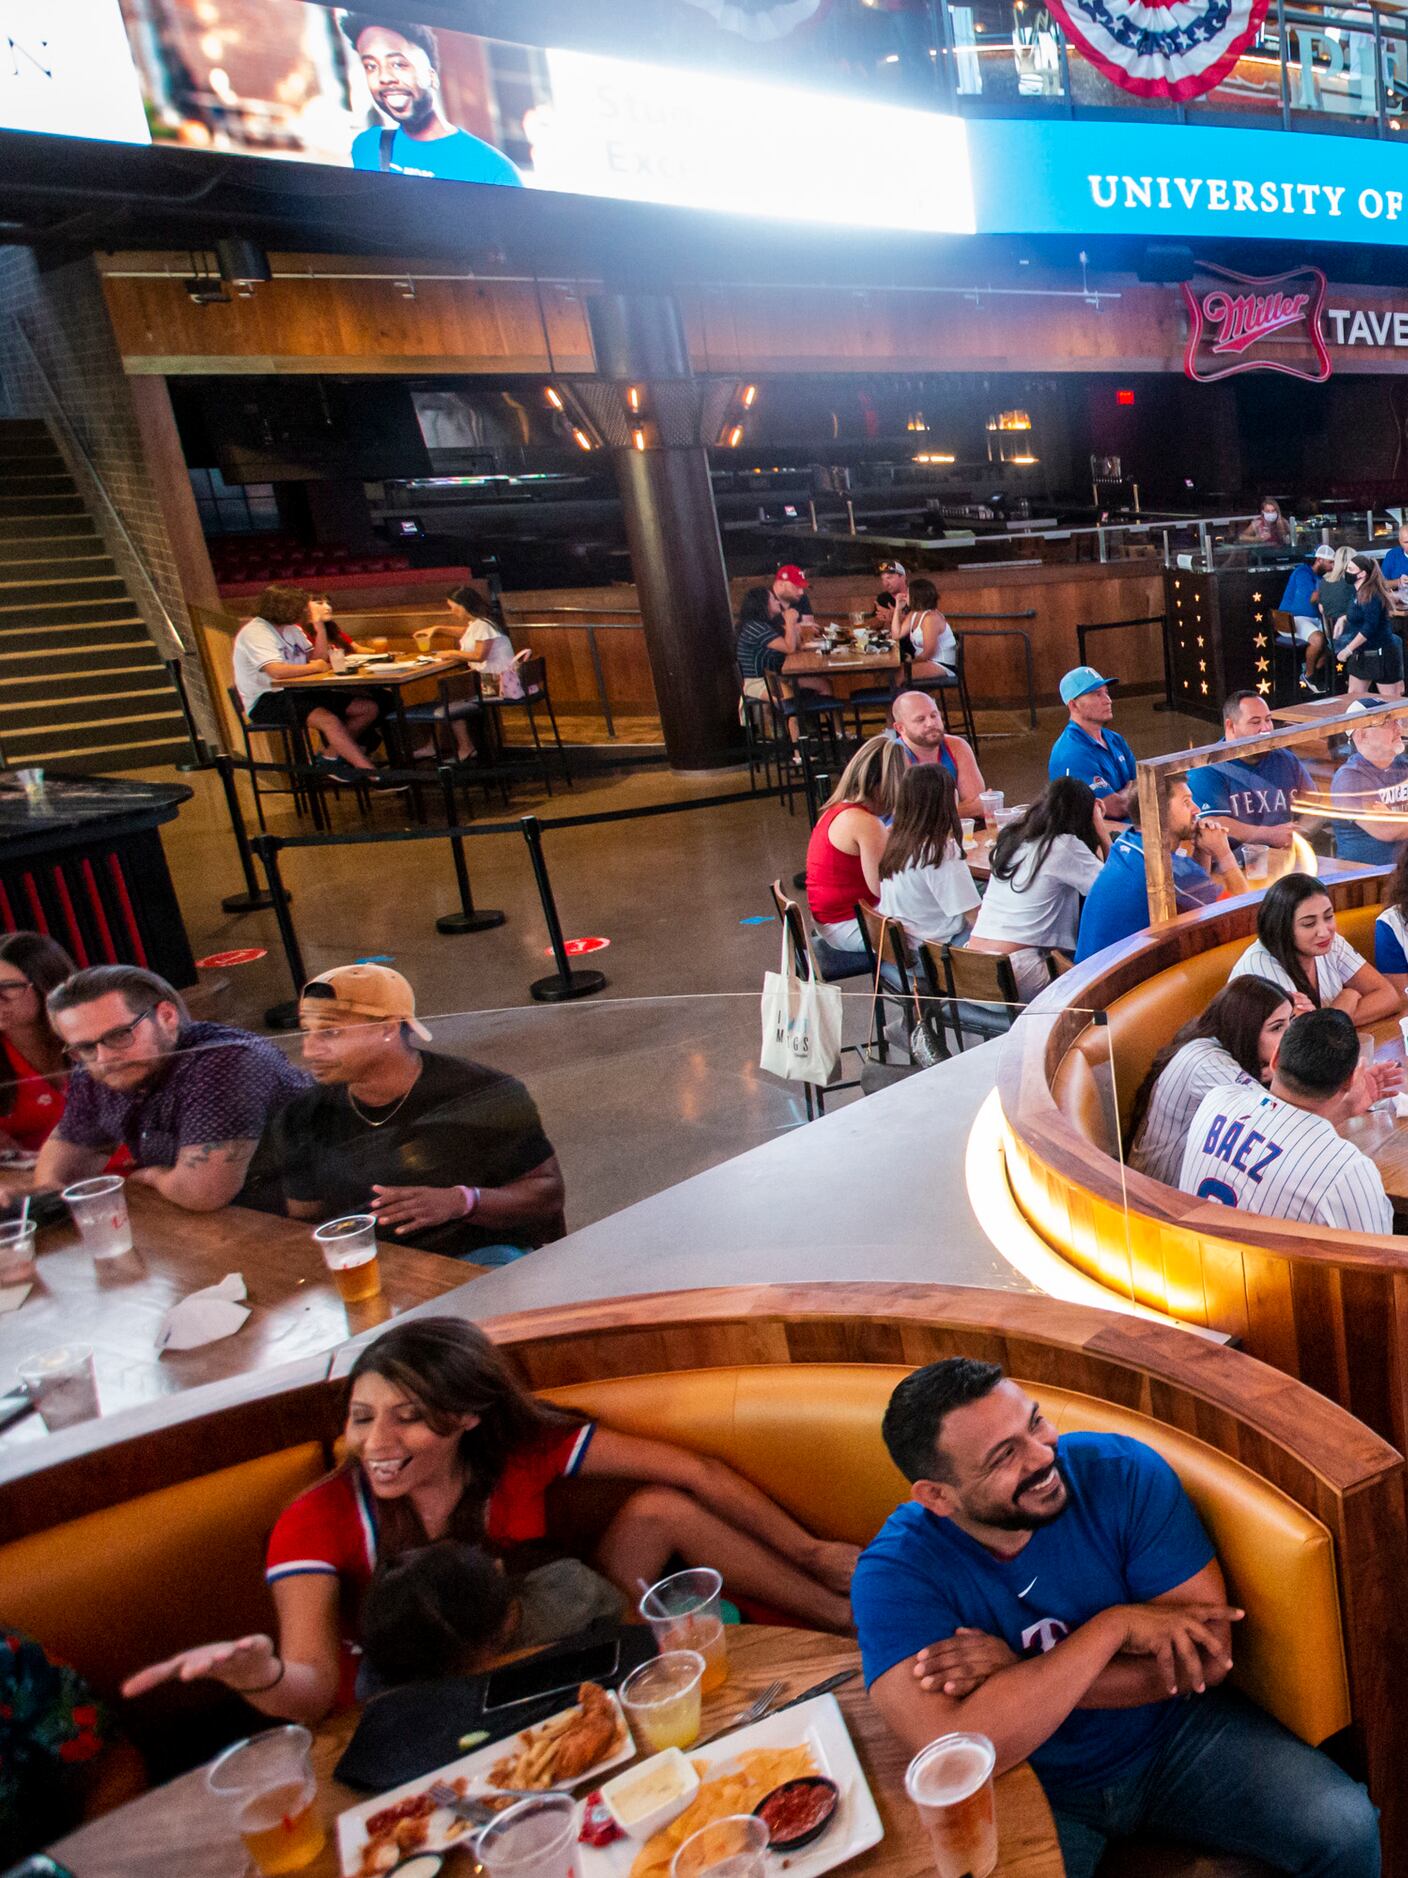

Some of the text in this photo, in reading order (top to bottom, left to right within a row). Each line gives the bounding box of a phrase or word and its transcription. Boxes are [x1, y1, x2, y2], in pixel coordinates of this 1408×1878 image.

[1088, 174, 1346, 217] UNIVERSITY
[1358, 187, 1402, 220] OF
[1203, 291, 1309, 347] Miller
[1229, 788, 1299, 817] TEXAS
[1202, 1113, 1284, 1185] BÁEZ
